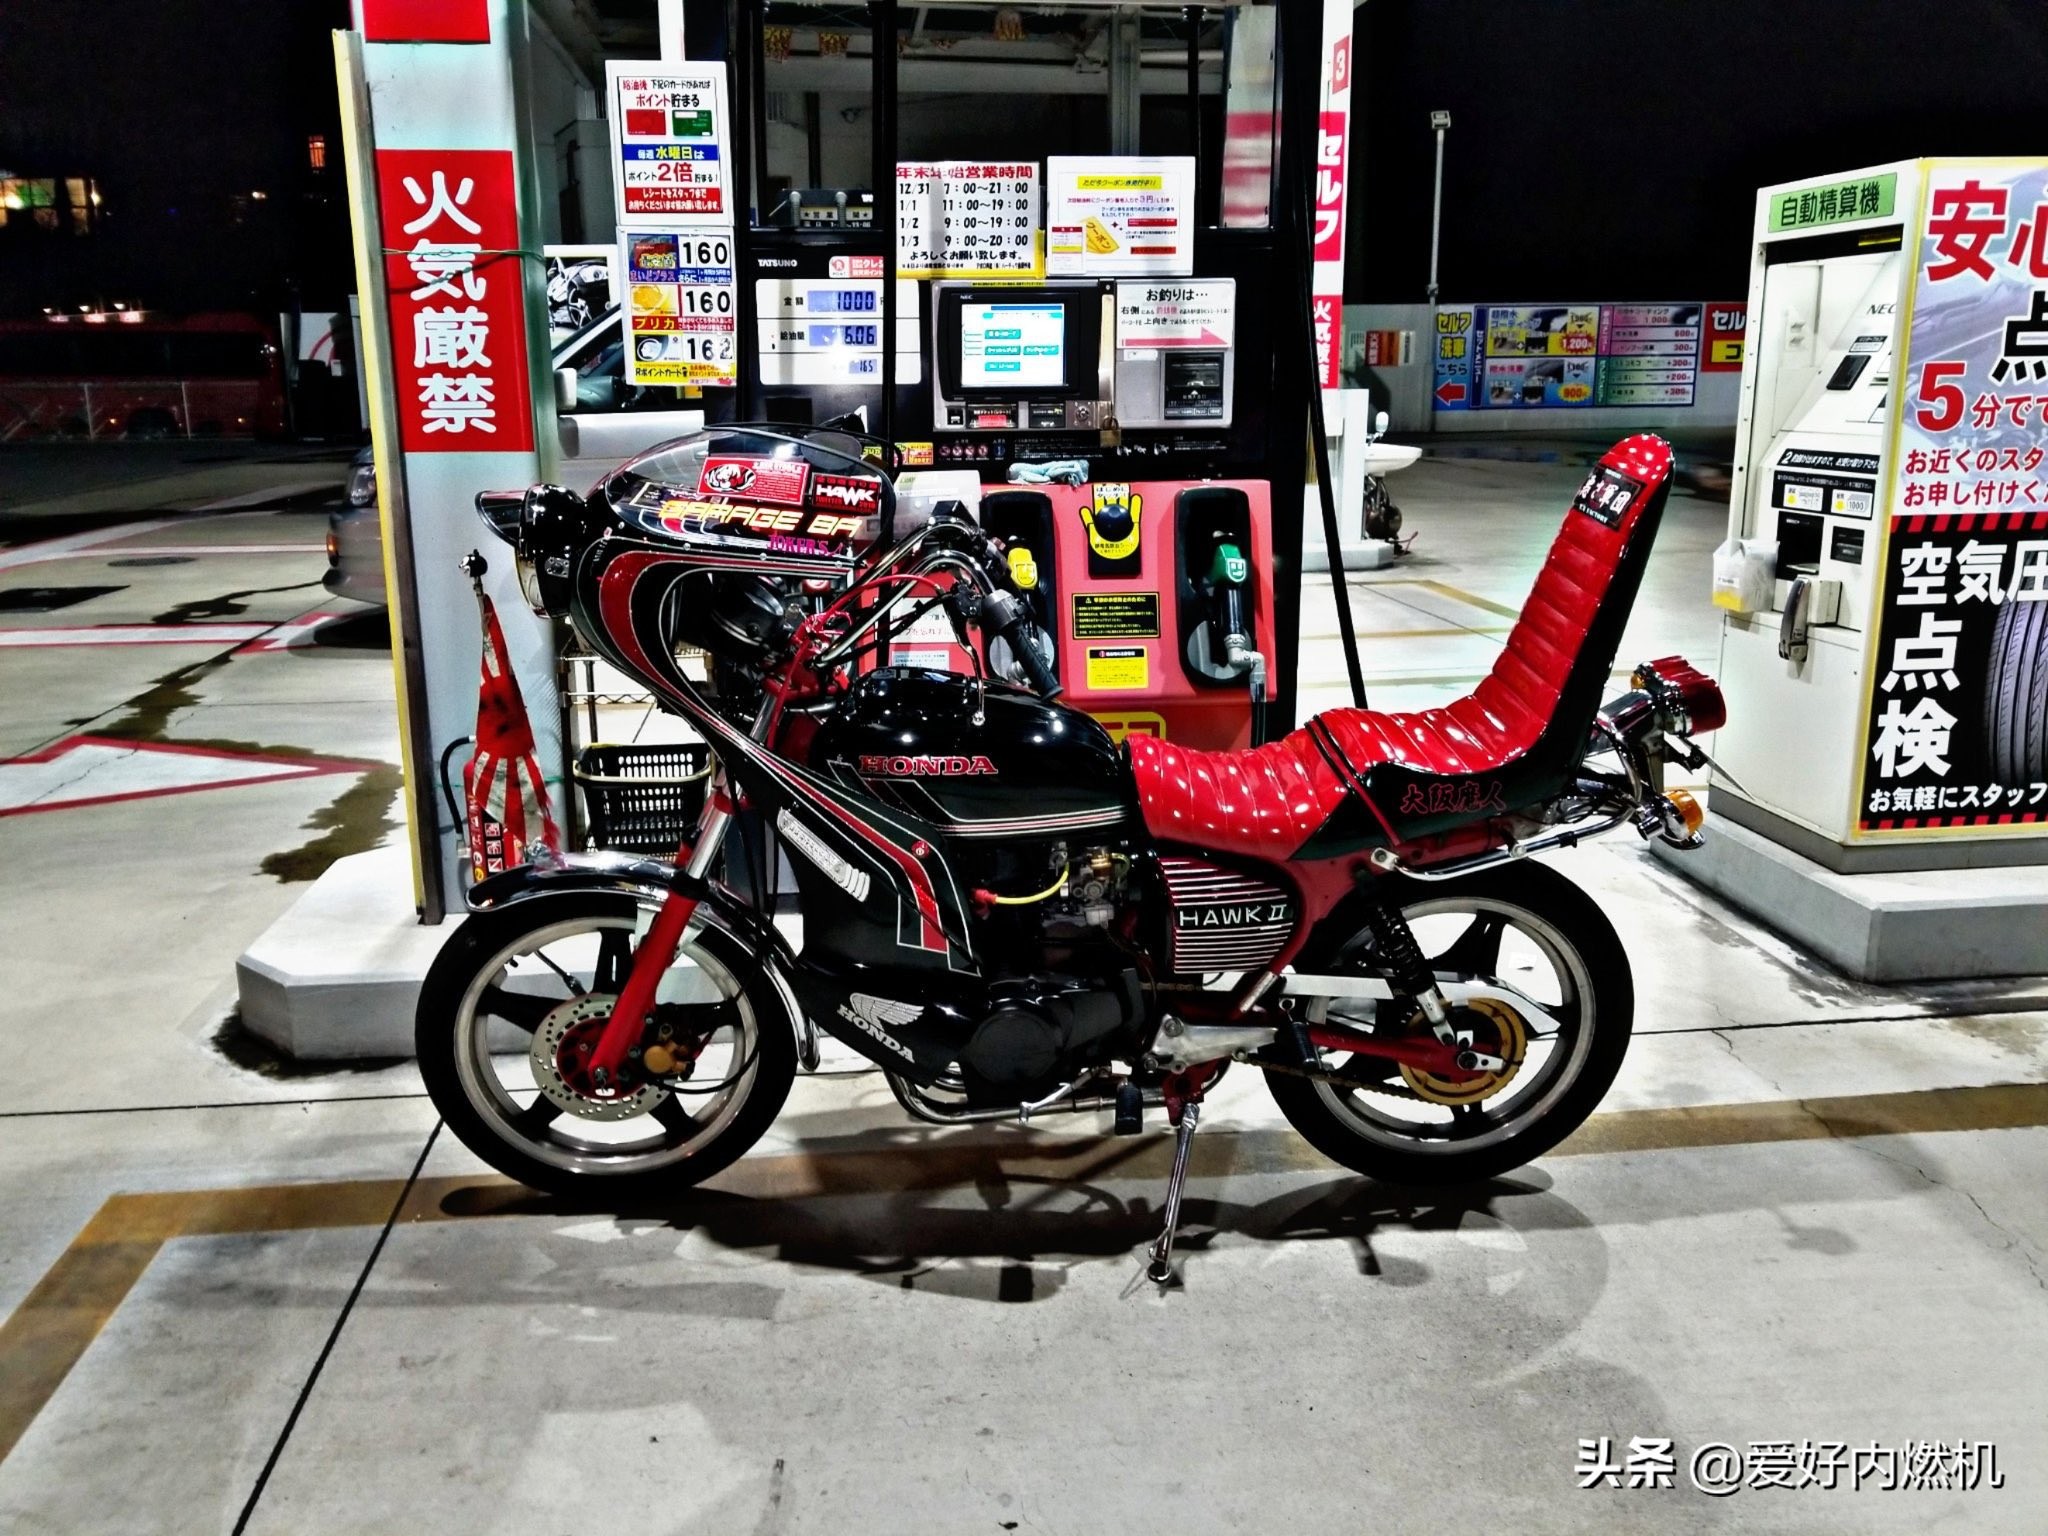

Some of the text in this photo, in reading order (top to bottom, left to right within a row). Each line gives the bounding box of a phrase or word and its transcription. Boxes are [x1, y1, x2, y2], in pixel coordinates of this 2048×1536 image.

[636, 93, 700, 108] ポイント貯まる
[899, 182, 930, 195] 12/31
[1314, 129, 1343, 245] セルフ
[900, 200, 917, 211] 1/1
[1781, 181, 1880, 227] 自動精算機
[900, 217, 919, 229] 1/2
[901, 235, 919, 247] 1/3
[682, 241, 728, 265] 160
[758, 258, 798, 267] TATSUNO
[910, 250, 1022, 261] よろしくお願い致します。
[402, 170, 497, 434] 火気厳禁
[685, 290, 731, 314] 160
[837, 290, 874, 310] 1000
[1866, 303, 1896, 315] NEC
[1144, 317, 1168, 326] 上向き
[1436, 312, 1473, 334] セルフ
[687, 337, 733, 361] 162
[859, 359, 874, 373] 165
[1436, 363, 1468, 376] こちら
[1905, 447, 2044, 475] お近くのスタ
[816, 484, 877, 506] HAWK
[1904, 480, 2048, 507] お申し付けく
[658, 499, 803, 531] GARAGE
[1896, 538, 2048, 606] 空気圧
[858, 755, 999, 776] HONDA
[1868, 782, 2047, 813] お気軽にスタッフ
[1179, 905, 1262, 926] HAWK
[836, 1003, 914, 1060] HONDA
